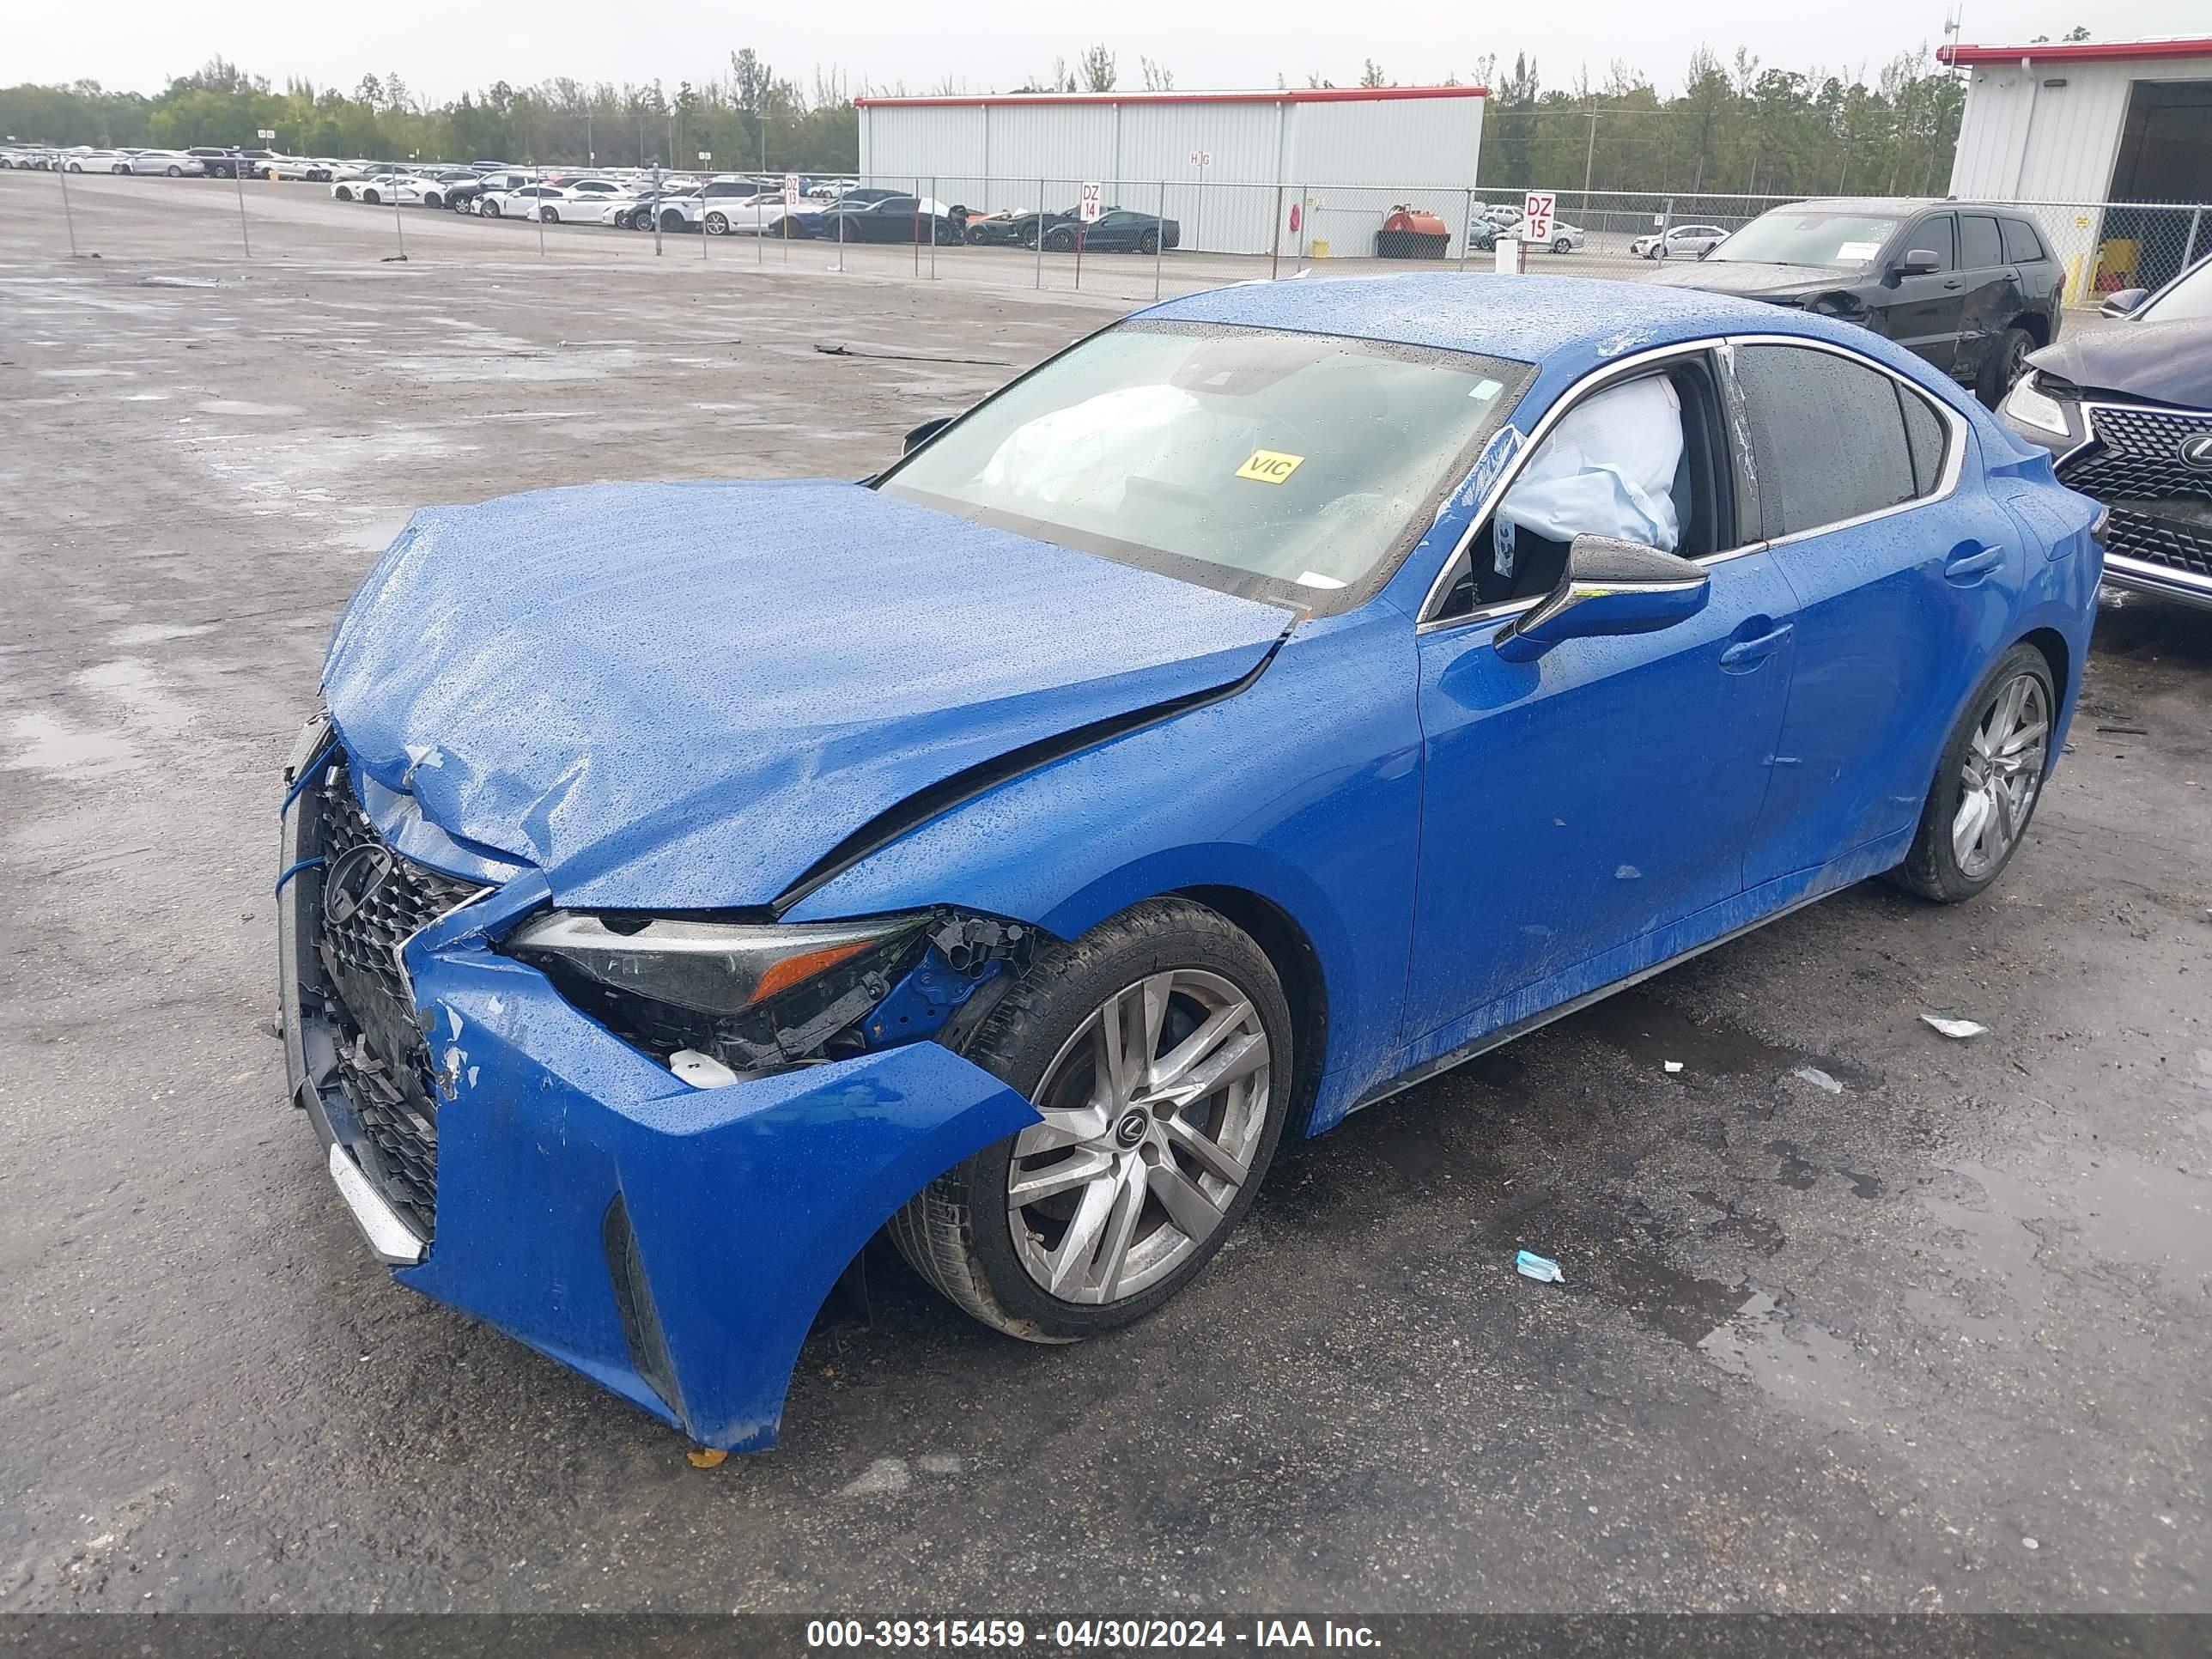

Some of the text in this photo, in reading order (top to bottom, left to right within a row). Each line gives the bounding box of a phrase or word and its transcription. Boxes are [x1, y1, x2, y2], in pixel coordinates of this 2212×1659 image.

[787, 178, 798, 191] DZ
[1083, 185, 1099, 200] DZ
[789, 191, 796, 205] 13
[1085, 202, 1095, 218] 14
[1528, 197, 1553, 216] DZ
[1530, 219, 1546, 238] 15
[1250, 457, 1291, 476] VIC
